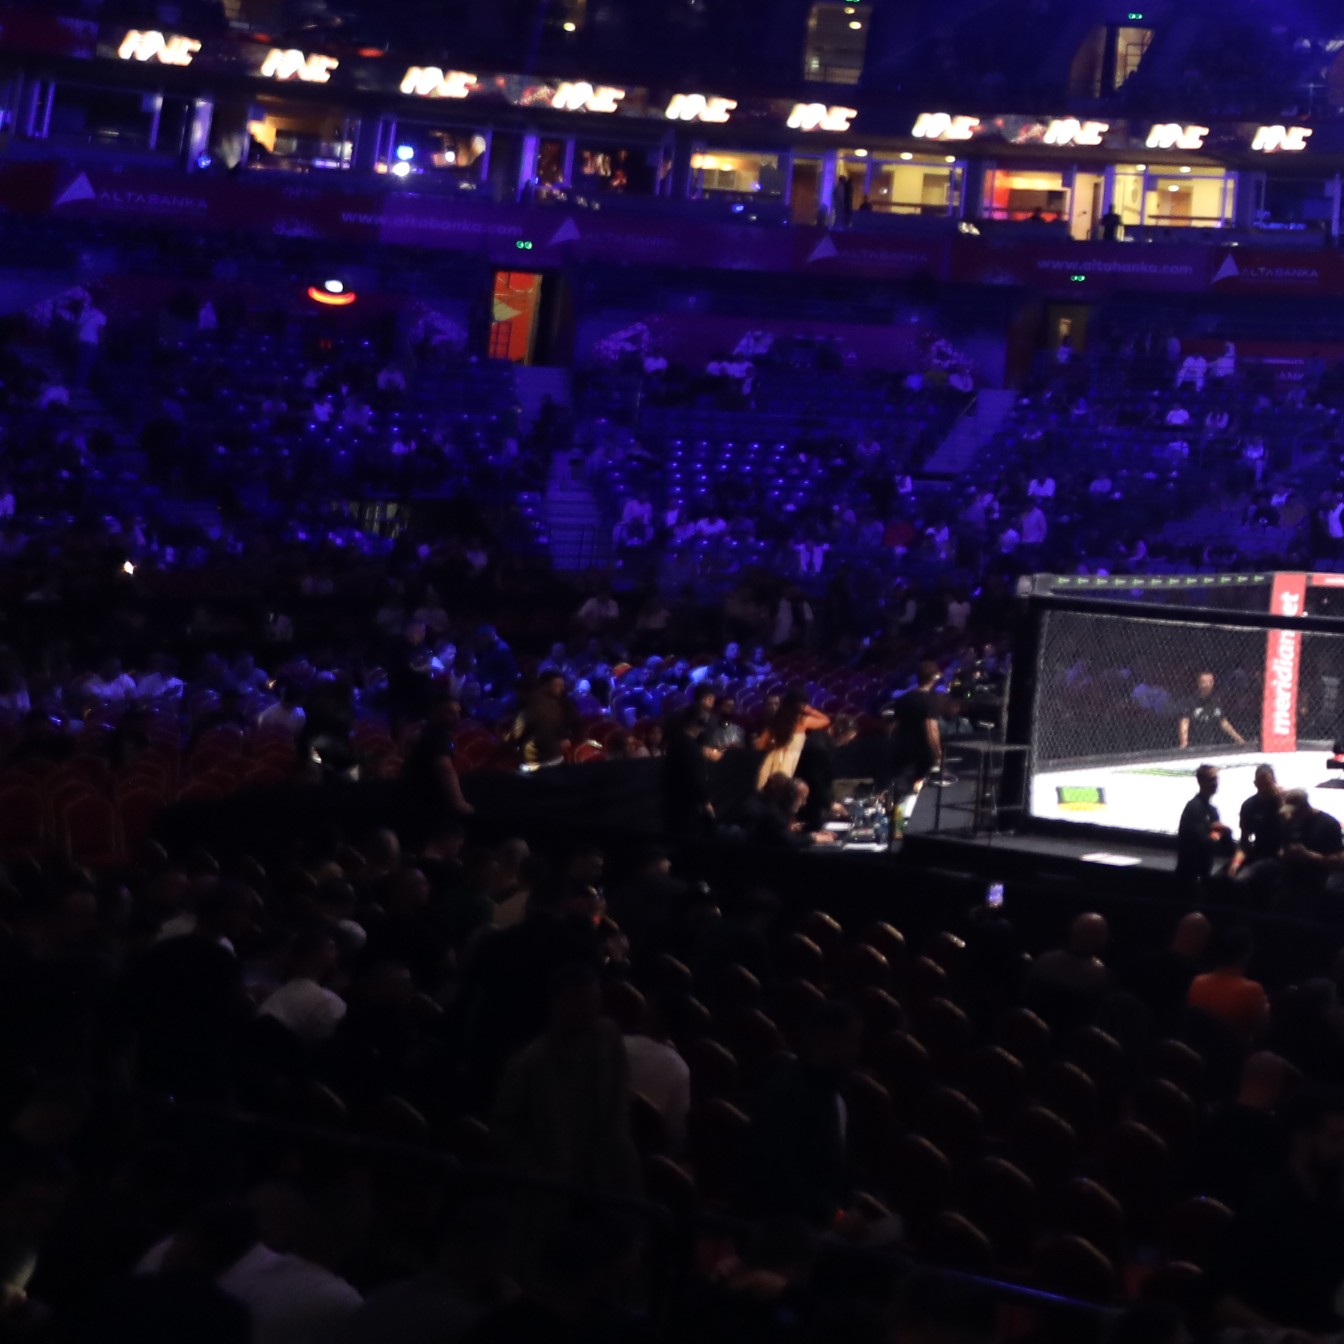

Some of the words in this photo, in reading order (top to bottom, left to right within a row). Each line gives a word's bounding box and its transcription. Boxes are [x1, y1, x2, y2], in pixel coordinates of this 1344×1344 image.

[1145, 123, 1210, 150] FNC
[1251, 124, 1313, 153] FNC
[1272, 591, 1300, 735] meridianet
